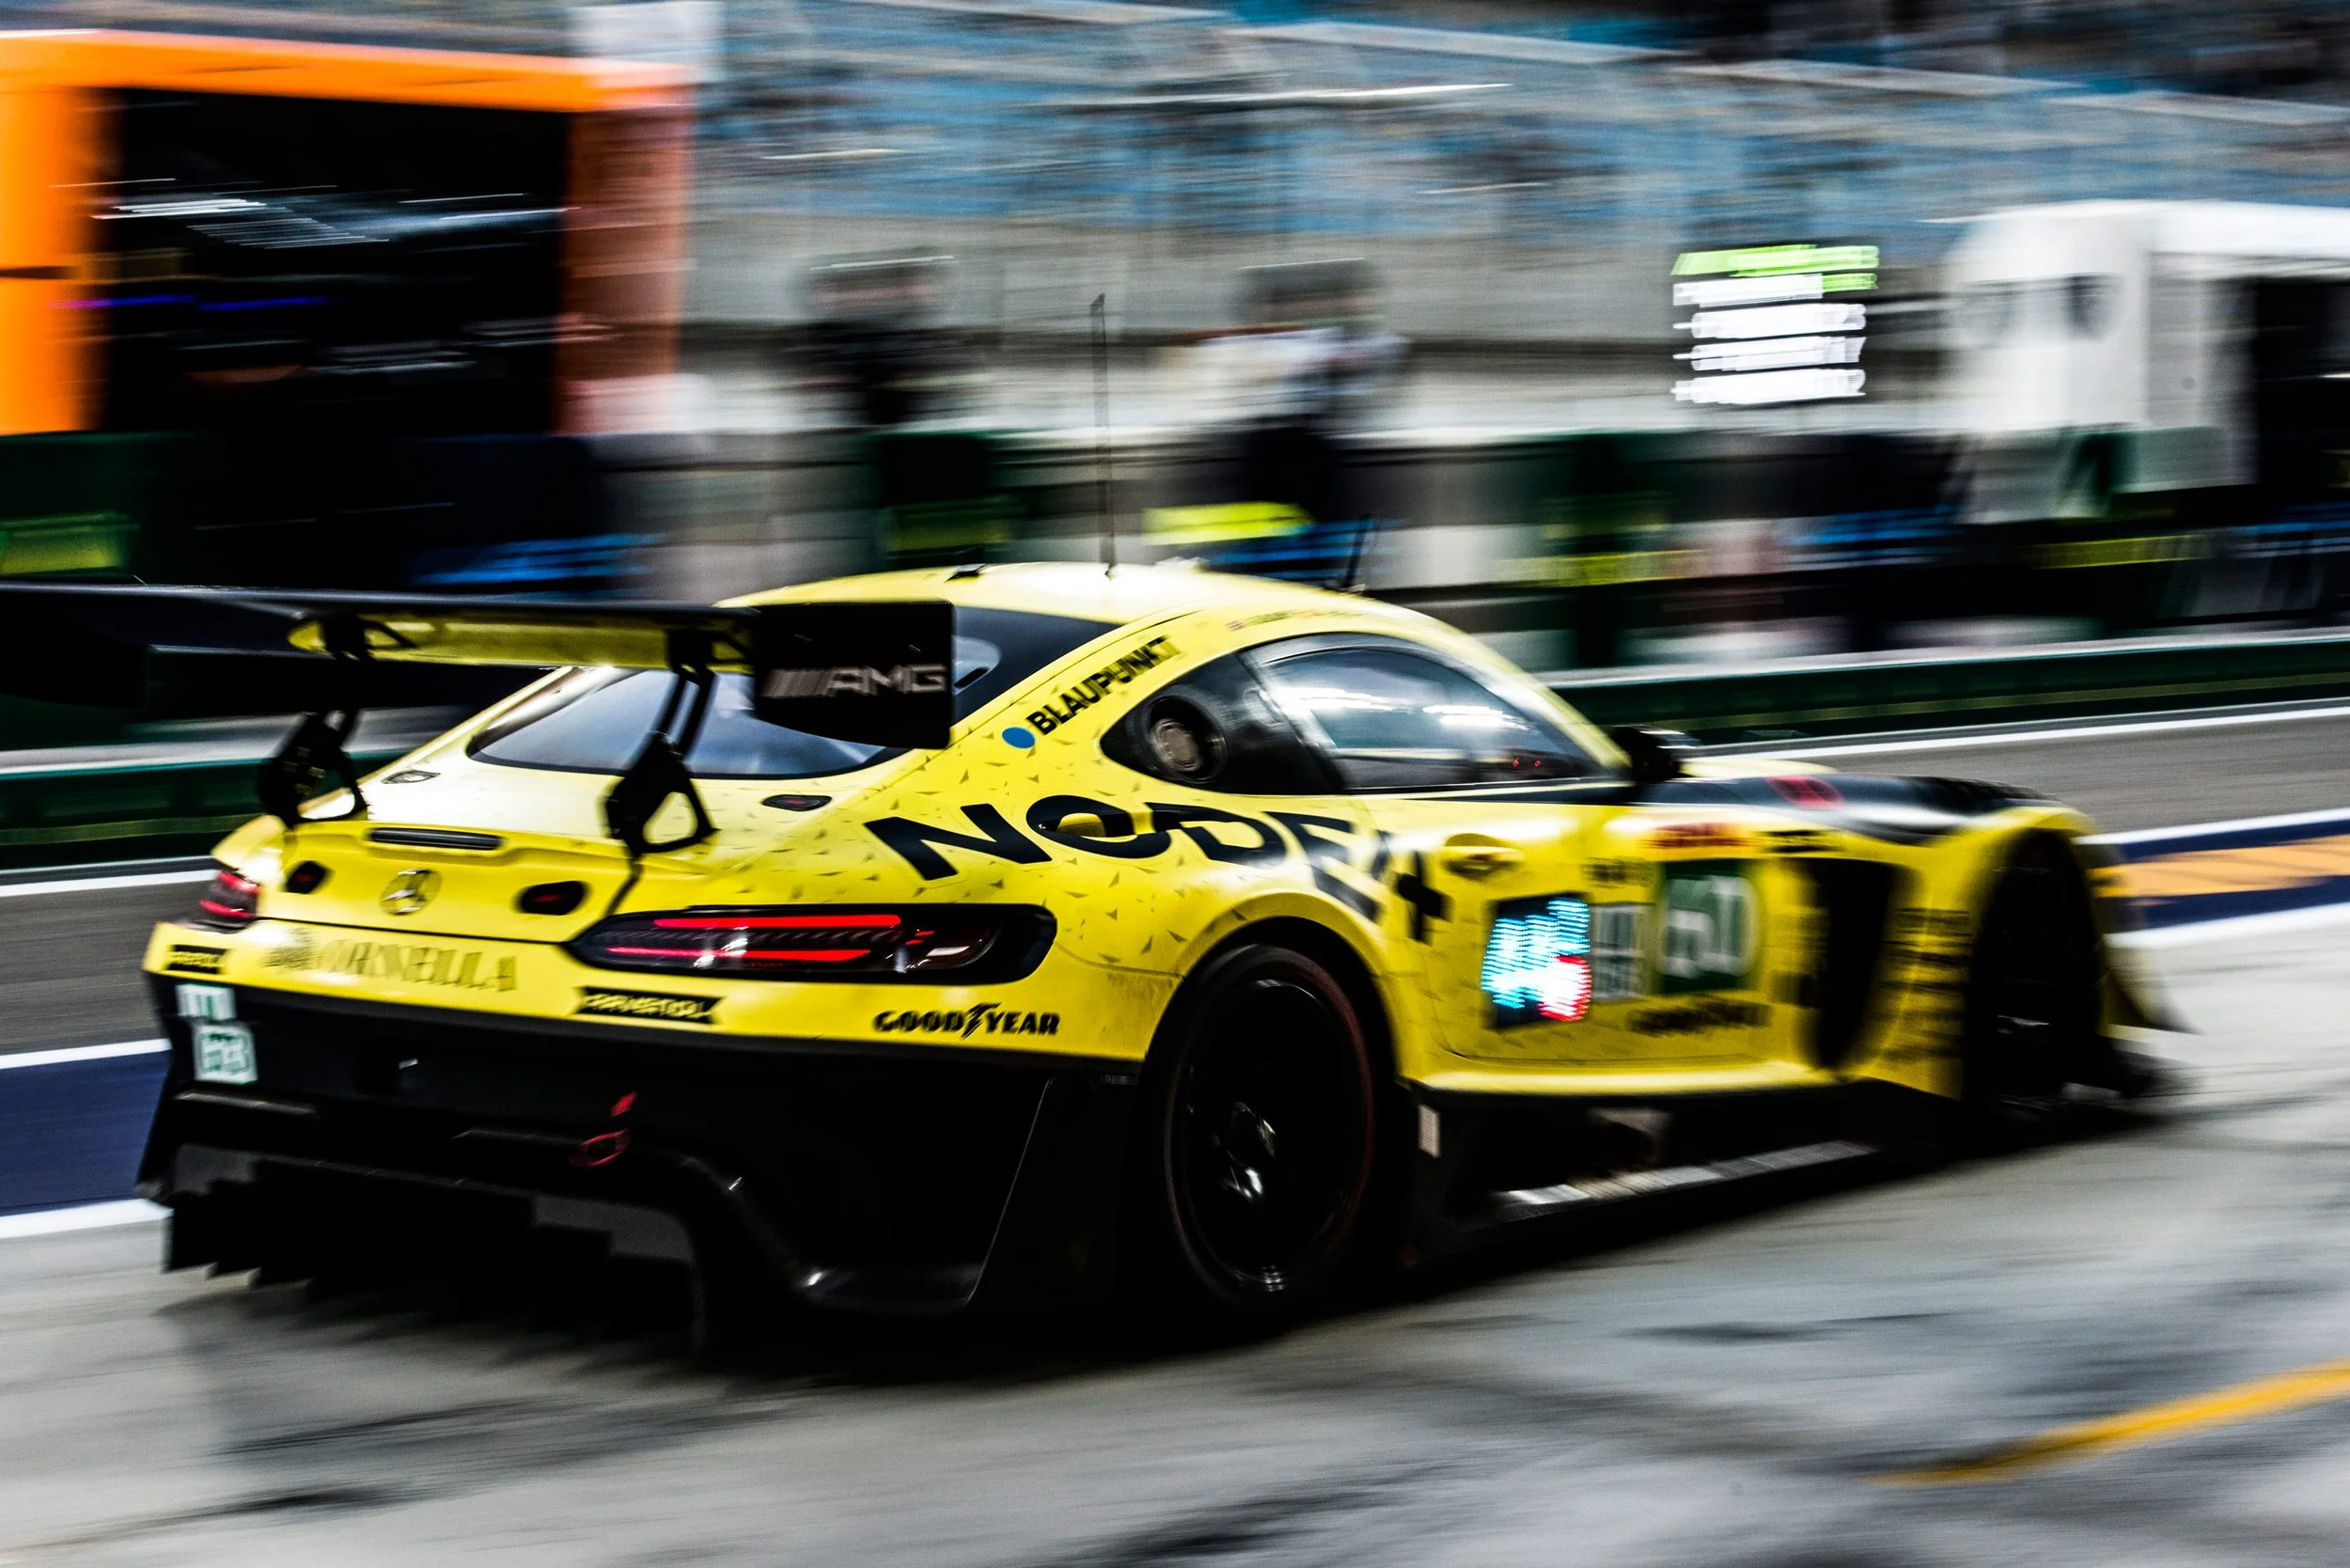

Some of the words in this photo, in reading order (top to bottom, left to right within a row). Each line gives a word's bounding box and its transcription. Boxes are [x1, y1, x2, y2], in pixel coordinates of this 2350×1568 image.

[825, 664, 948, 698] AMG
[1026, 634, 1181, 735] BLAUPUNKT
[871, 1001, 1062, 1041] GOODYEAR
